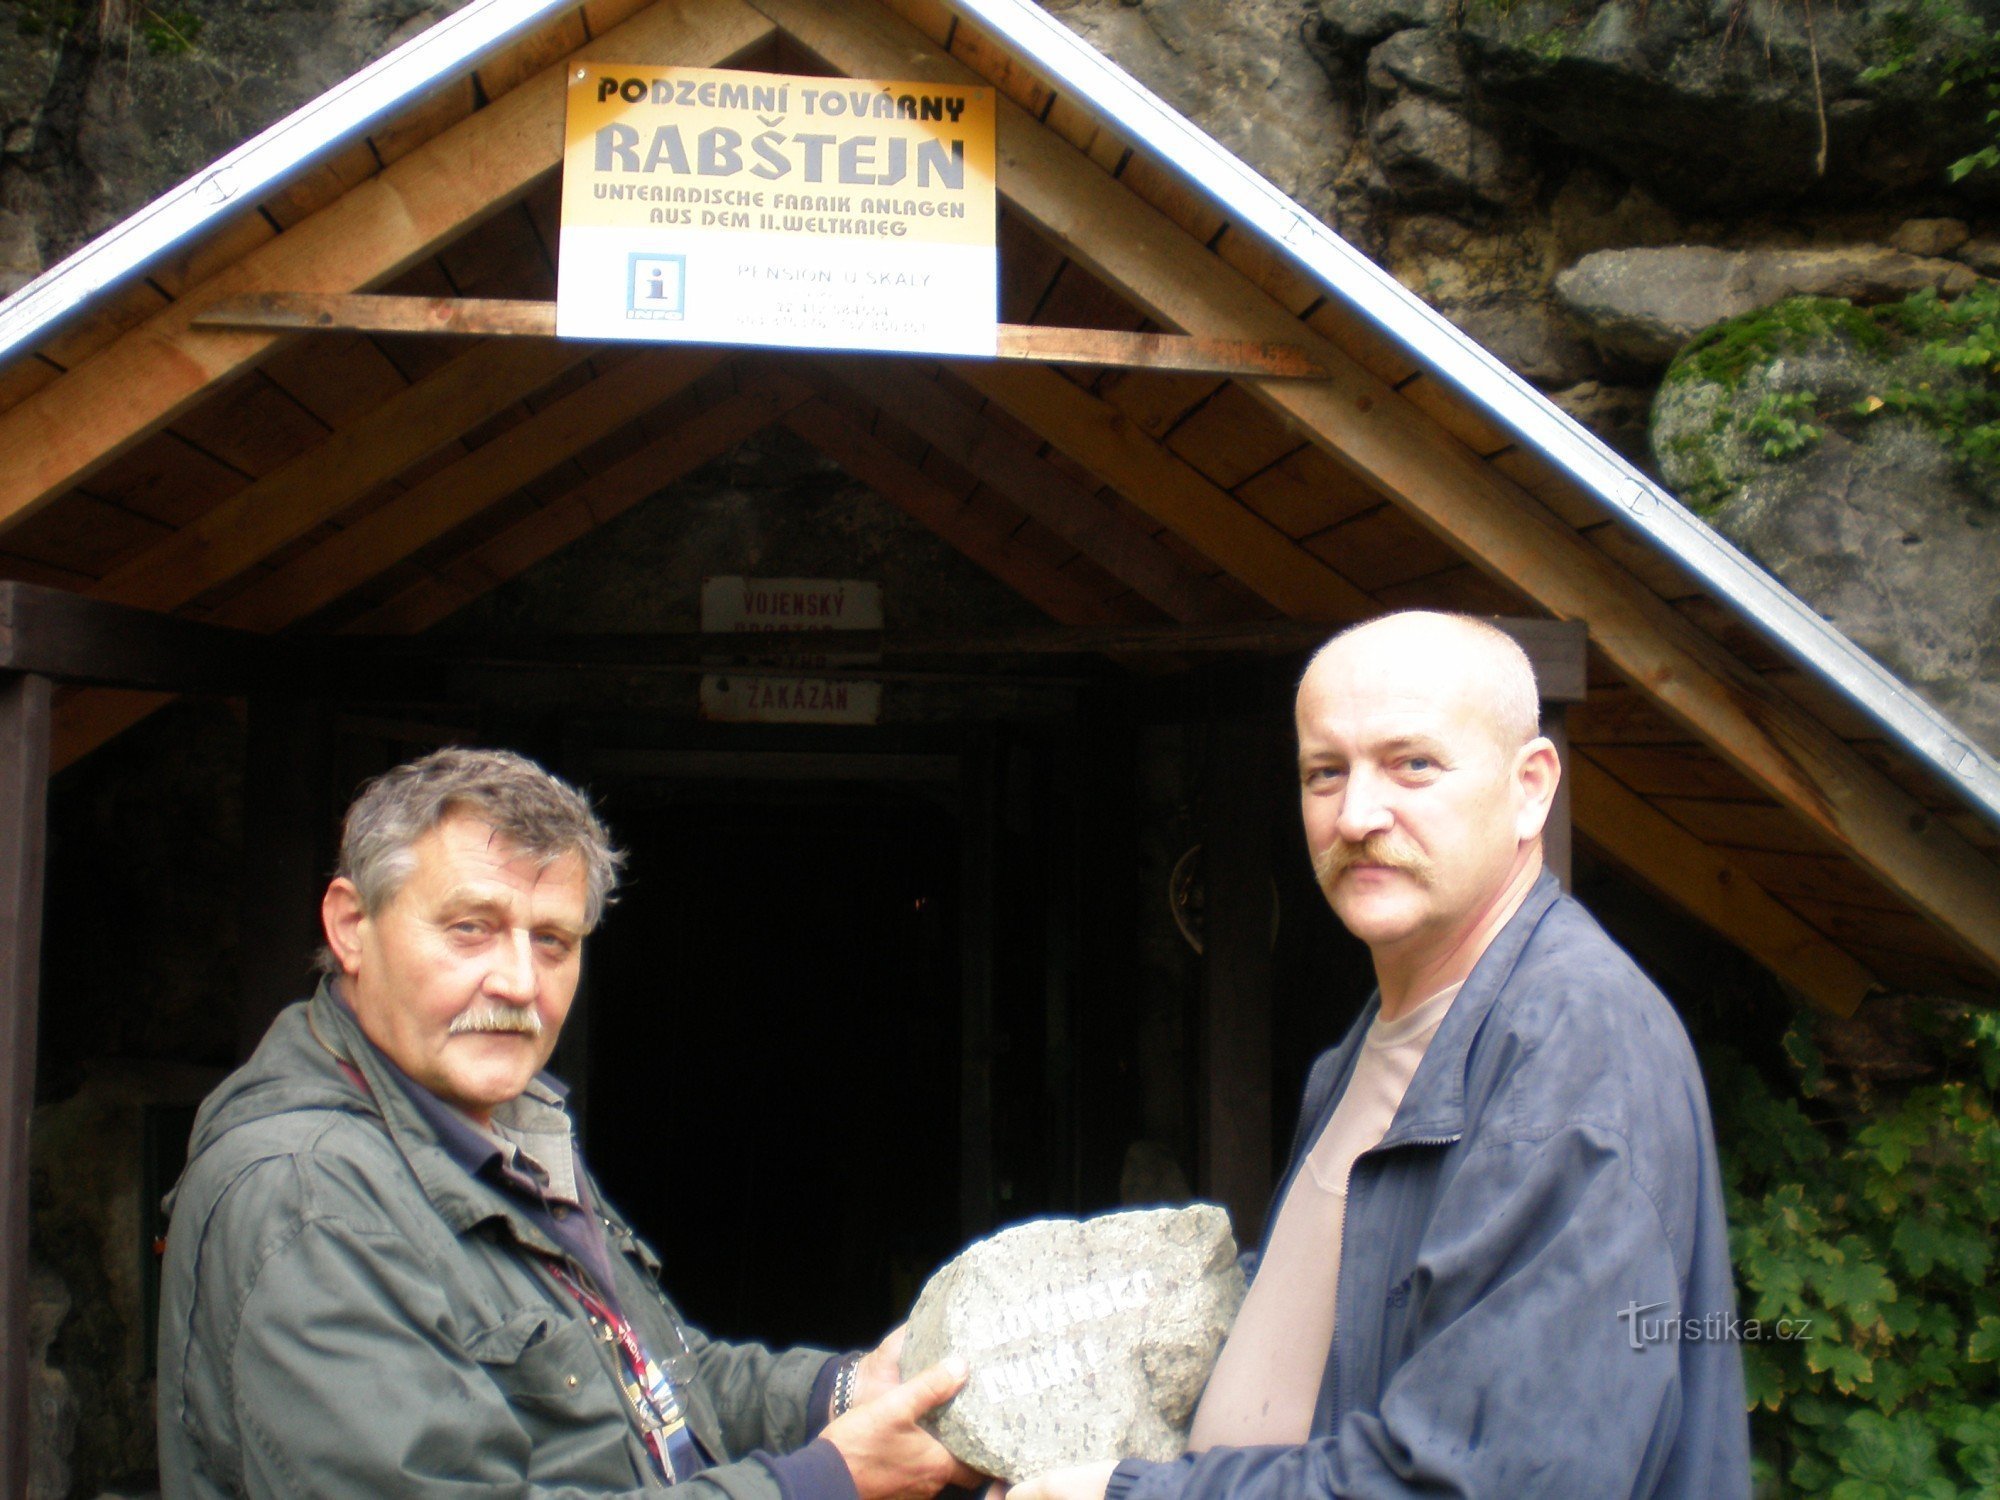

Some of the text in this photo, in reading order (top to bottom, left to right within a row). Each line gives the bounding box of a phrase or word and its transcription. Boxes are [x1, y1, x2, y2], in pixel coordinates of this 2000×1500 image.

[597, 77, 965, 123] PODZEMNÍ TOVÁRNY
[594, 114, 965, 190] RABŠTEJN
[650, 207, 692, 225] AUS
[701, 210, 750, 228] DEM
[773, 193, 851, 213] FABRIK
[860, 198, 965, 218] ANLAGEN
[738, 264, 832, 284] PENSION
[743, 586, 845, 617] VOJENSKÝ
